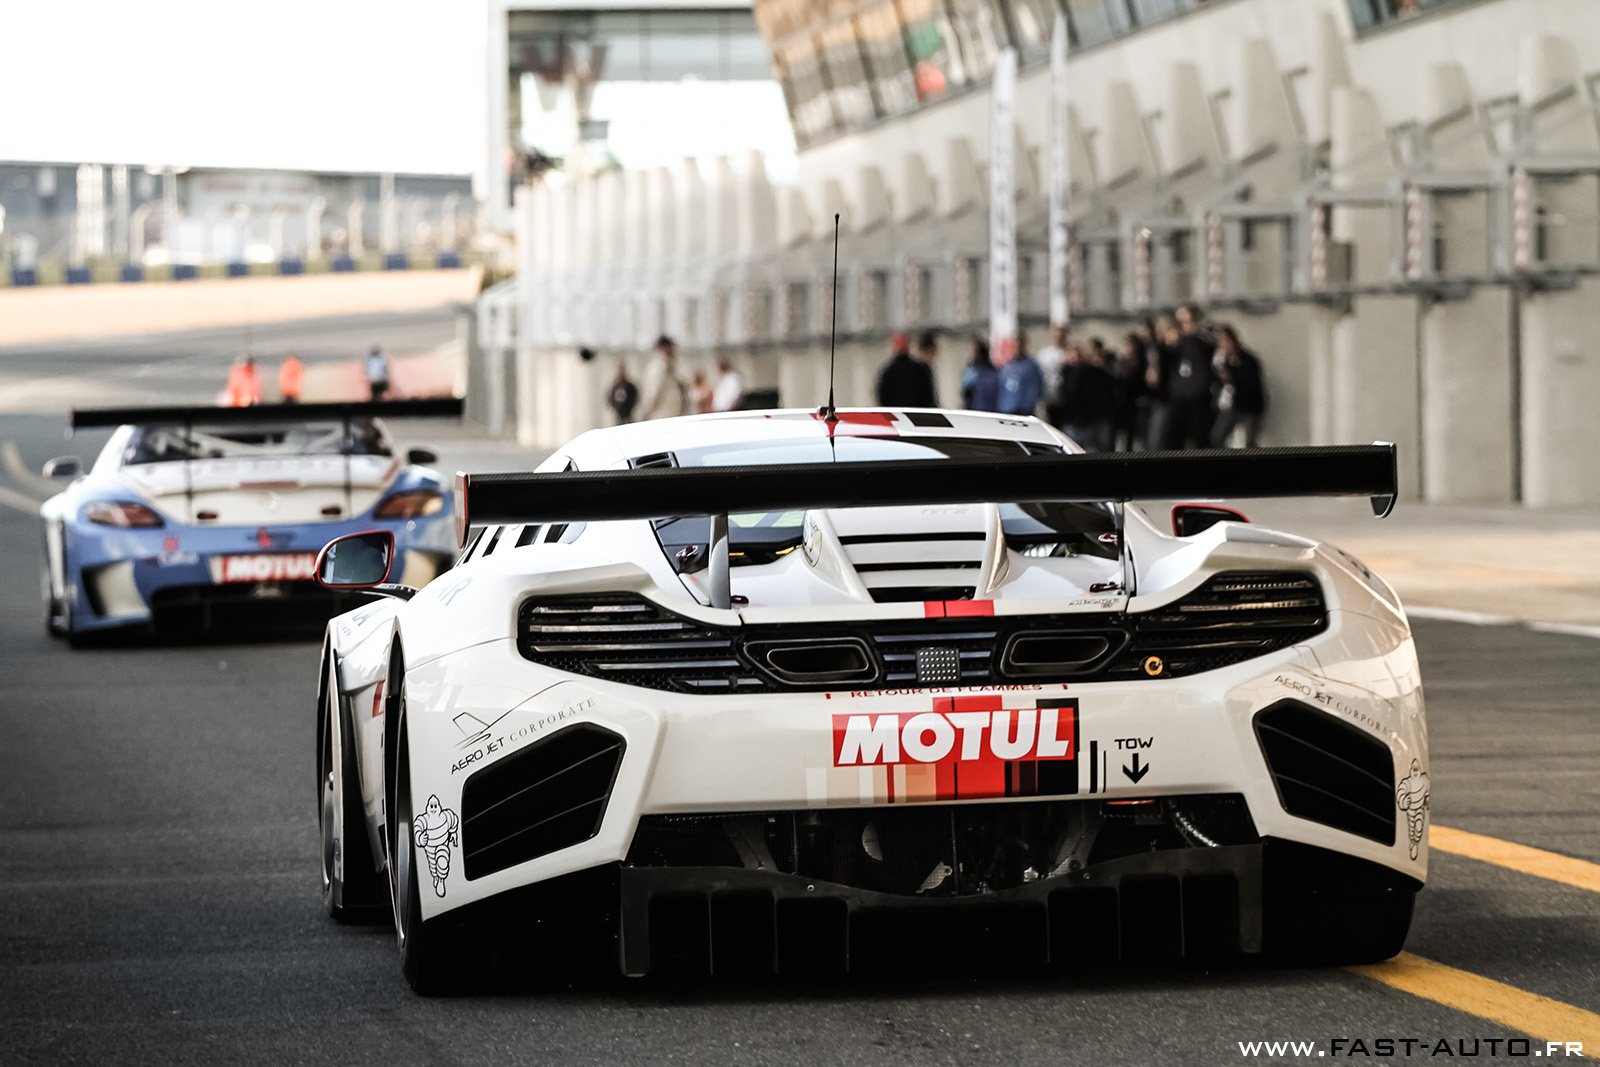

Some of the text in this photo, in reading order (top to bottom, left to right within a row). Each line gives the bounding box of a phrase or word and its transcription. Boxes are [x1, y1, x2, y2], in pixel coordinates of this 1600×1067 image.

[1274, 675, 1311, 696] AERO
[1314, 690, 1333, 705] JET
[451, 698, 596, 775] AERO JET CORPORATE
[837, 708, 1070, 765] MOTUL
[1114, 736, 1154, 750] TOW
